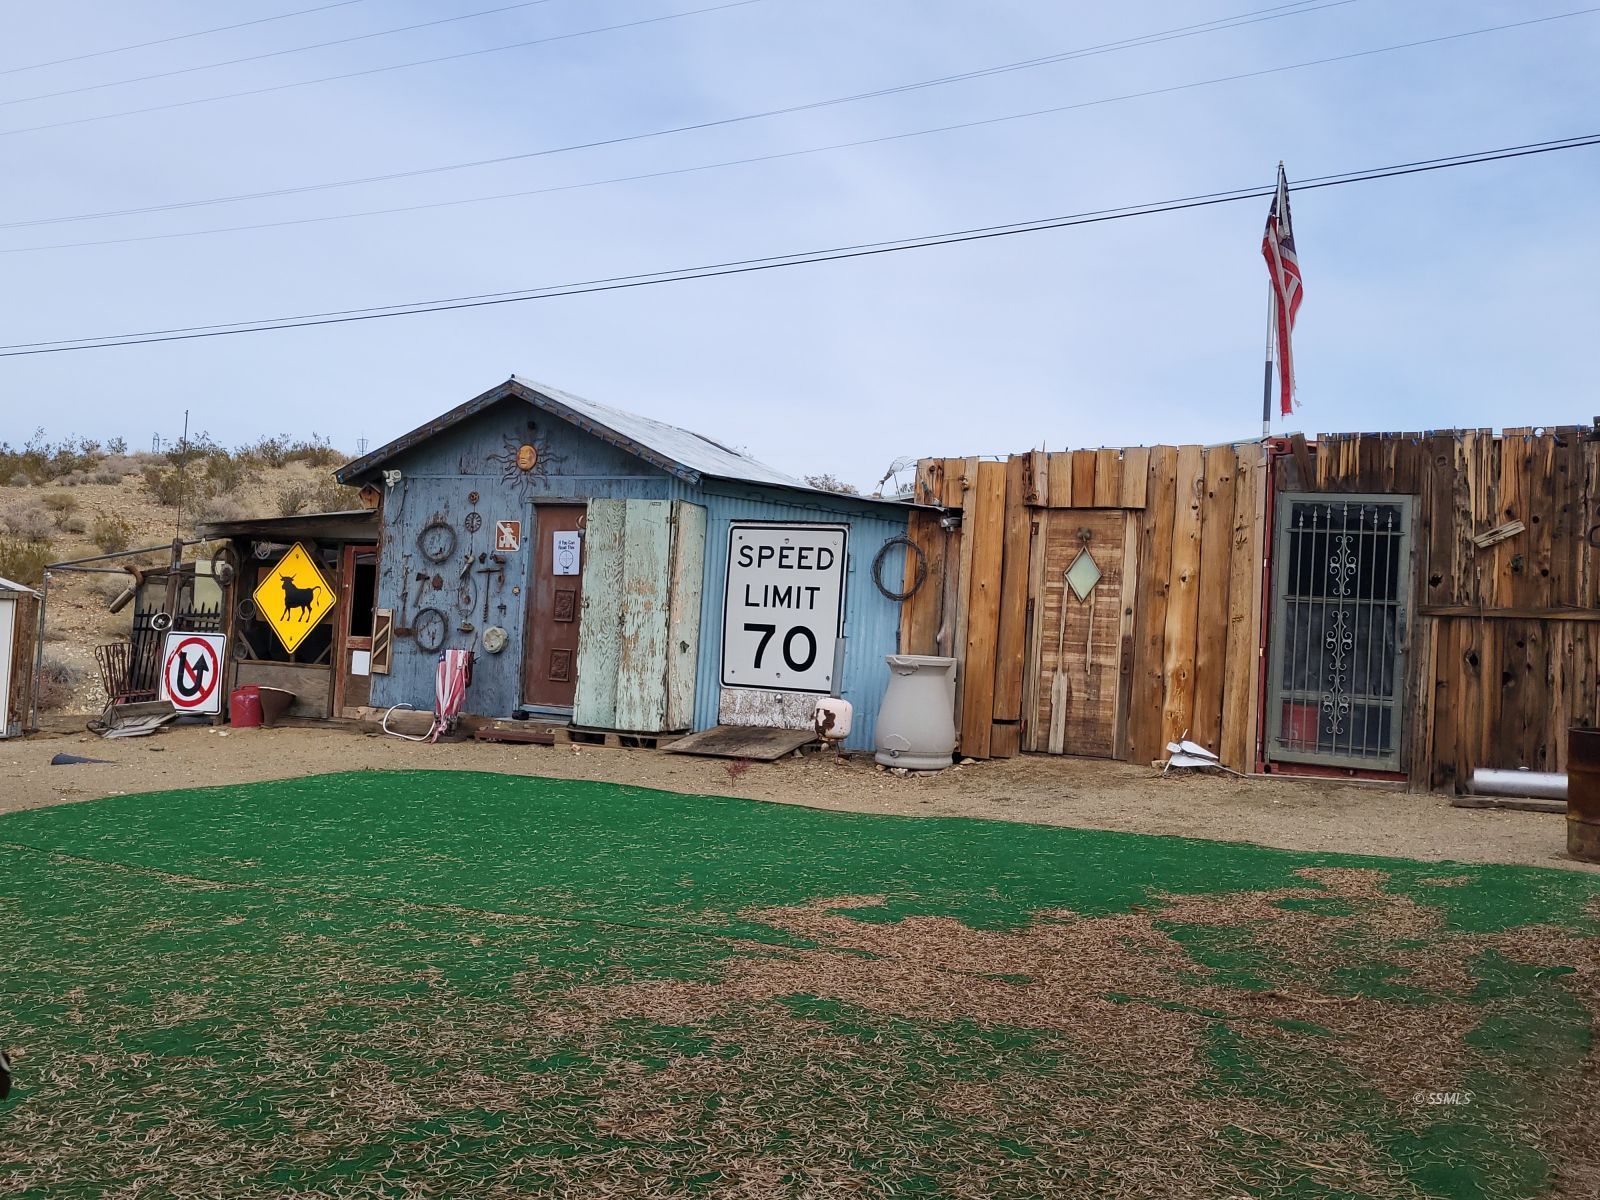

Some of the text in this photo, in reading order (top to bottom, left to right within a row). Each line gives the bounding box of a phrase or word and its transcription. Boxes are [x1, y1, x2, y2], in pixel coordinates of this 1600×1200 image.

[737, 545, 834, 571] SPEED
[744, 584, 820, 610] LIMIT
[743, 623, 817, 672] 70
